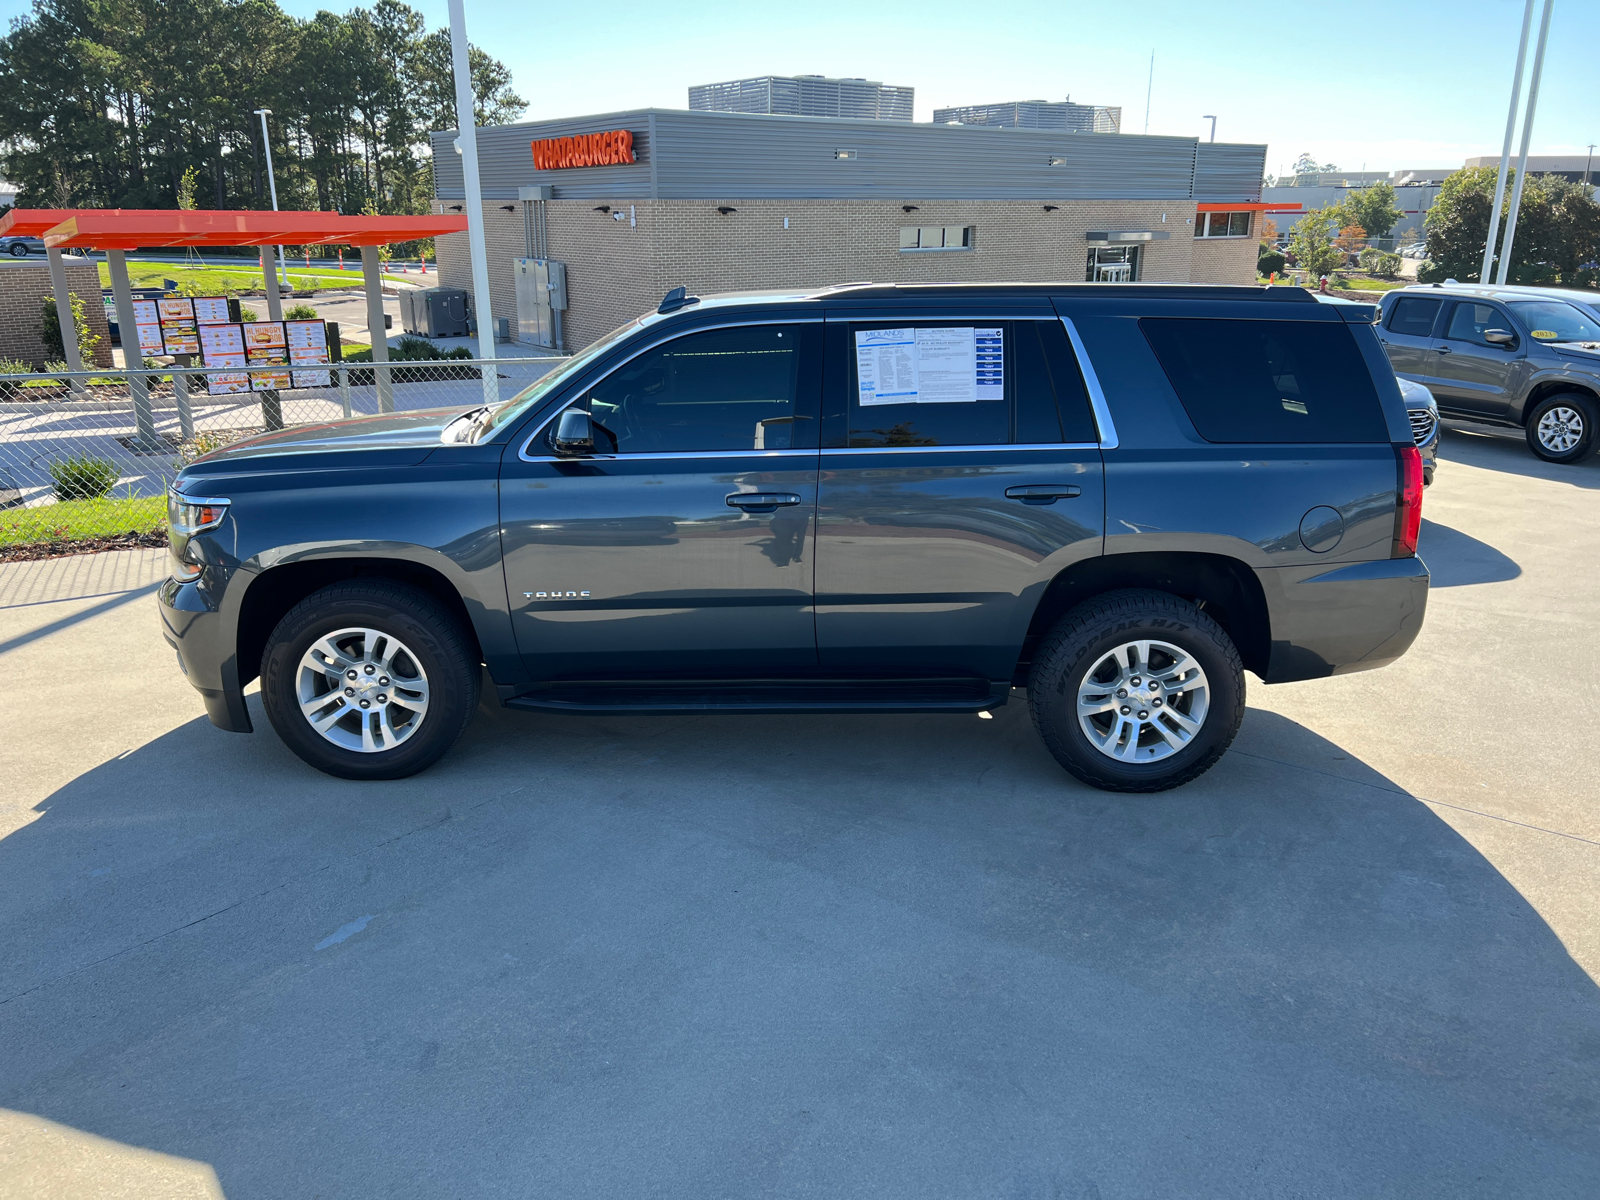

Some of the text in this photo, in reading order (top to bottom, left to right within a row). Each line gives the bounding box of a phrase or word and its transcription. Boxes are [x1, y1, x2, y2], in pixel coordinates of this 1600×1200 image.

[530, 129, 634, 170] WHATABURGER
[255, 326, 284, 334] HUNGRY.
[865, 330, 904, 338] MIDLANDS
[523, 590, 591, 600] TAHOE
[1056, 618, 1190, 697] WILDPEAK H/T
